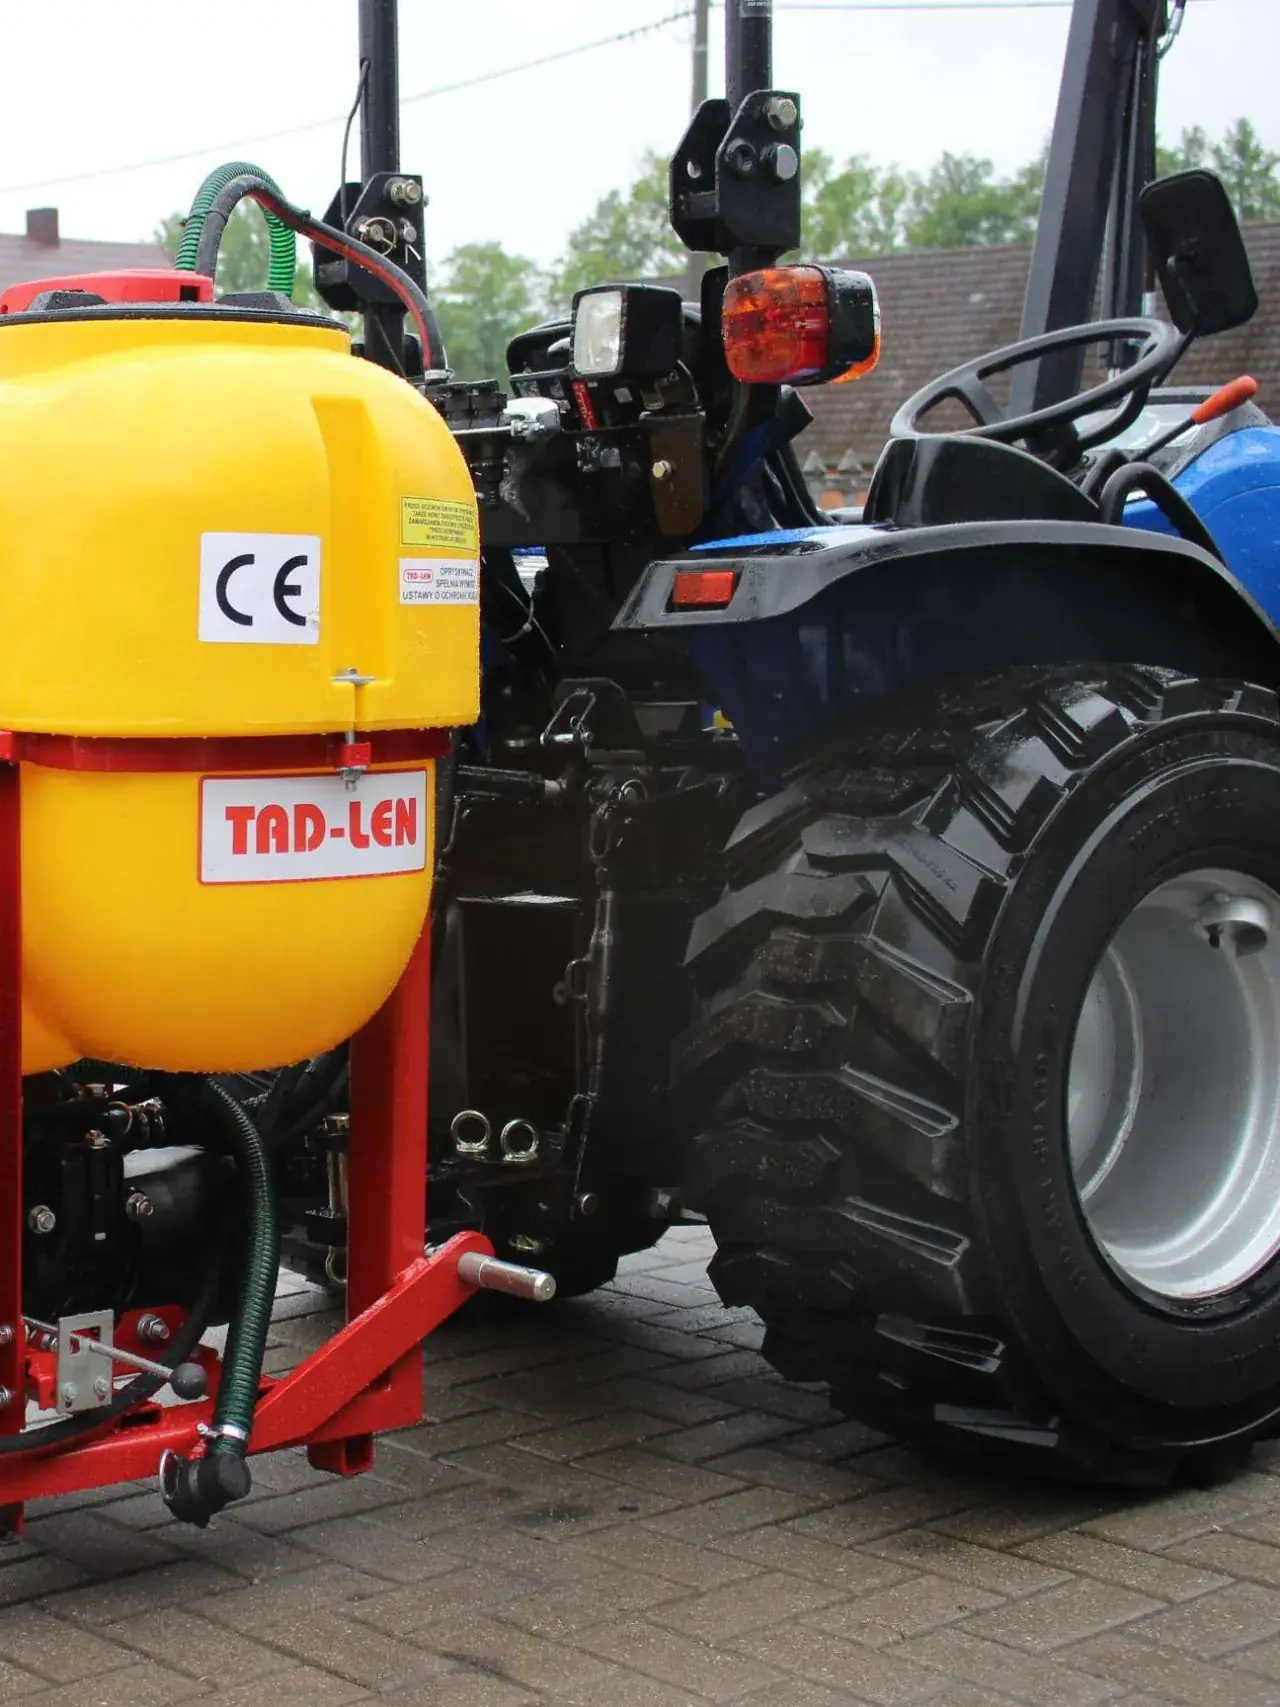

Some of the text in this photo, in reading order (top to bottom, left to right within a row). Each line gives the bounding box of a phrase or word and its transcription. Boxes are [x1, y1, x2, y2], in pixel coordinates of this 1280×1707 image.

[216, 554, 308, 627] CE
[402, 590, 433, 601] USTAWY
[434, 591, 440, 600] O
[225, 797, 417, 855] TAD-LEN
